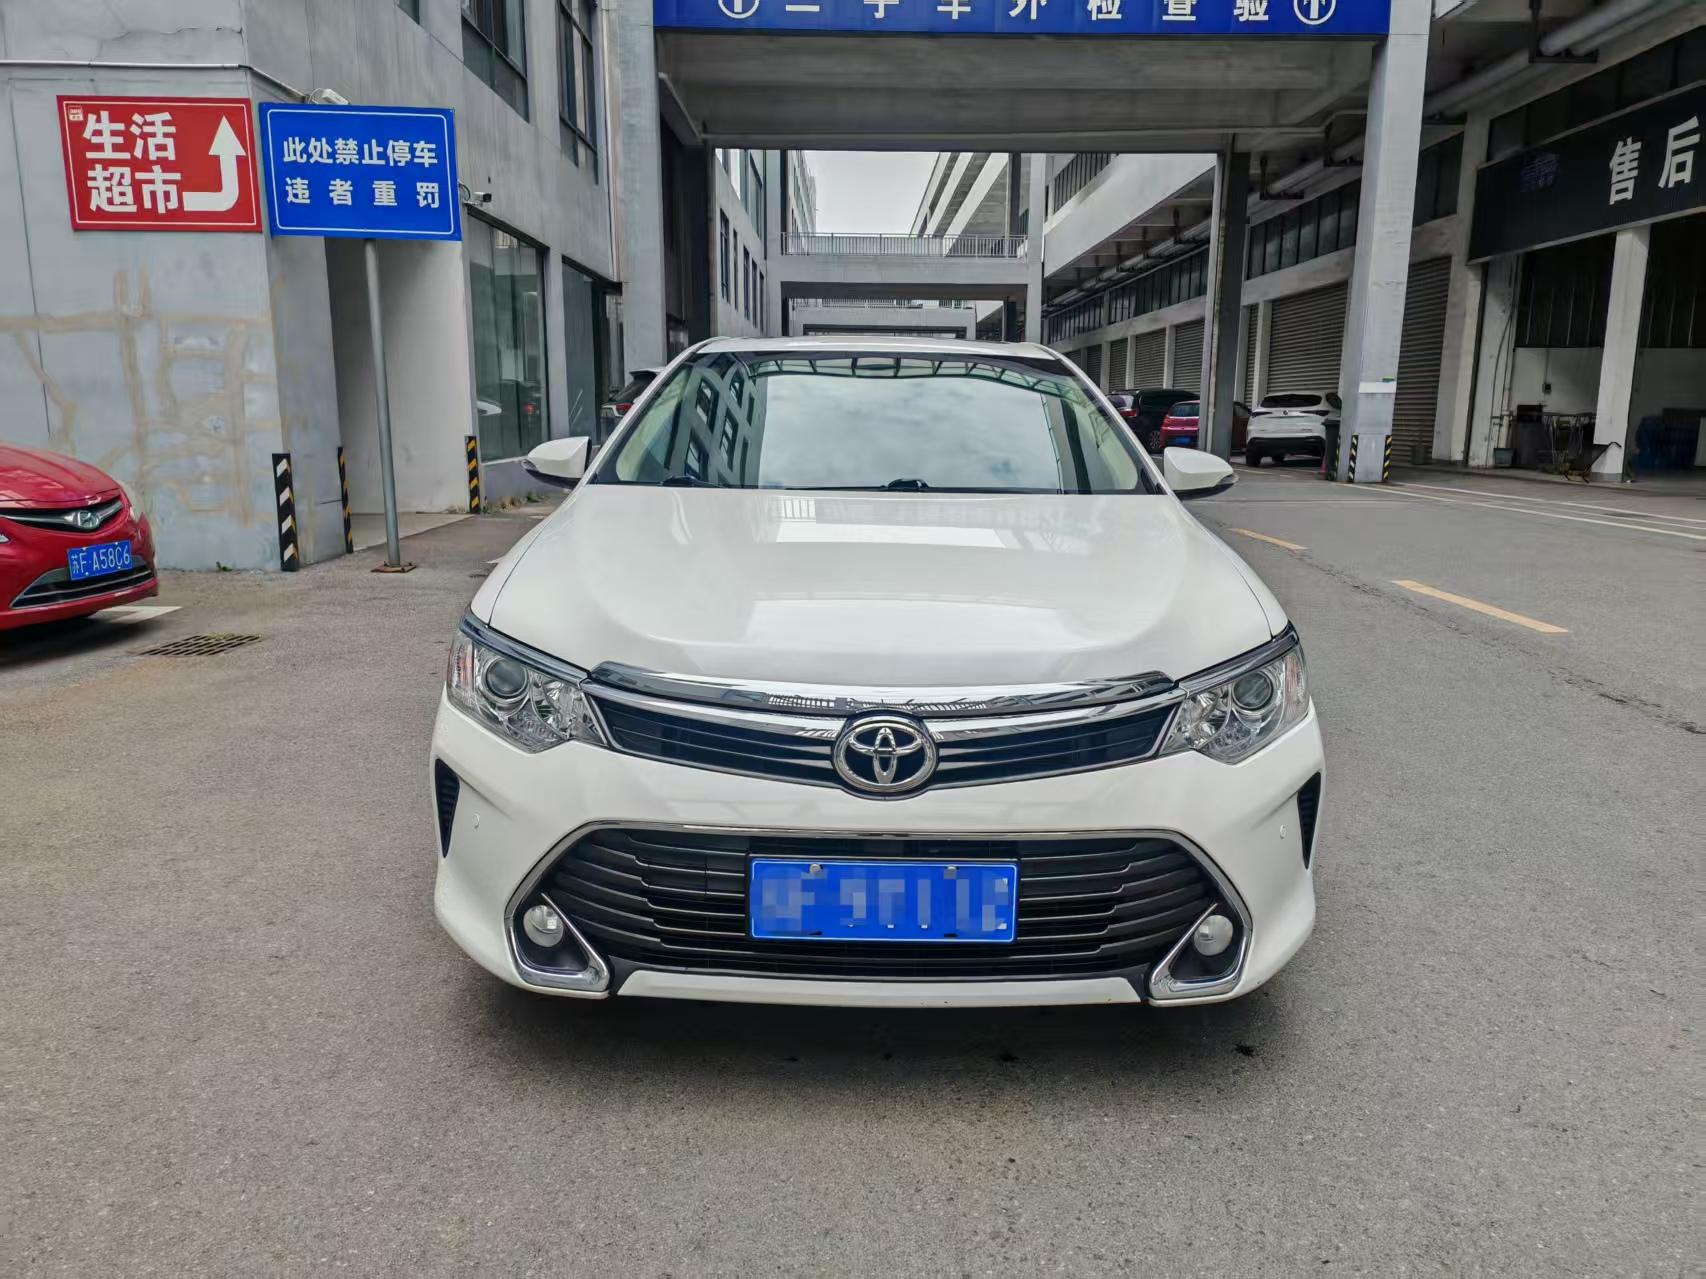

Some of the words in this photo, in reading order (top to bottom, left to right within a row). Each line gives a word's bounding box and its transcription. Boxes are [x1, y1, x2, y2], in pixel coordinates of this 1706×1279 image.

[83, 111, 176, 160] 生活
[283, 137, 438, 167] 此处禁止停车
[1608, 116, 1700, 205] 售后
[87, 164, 181, 213] 超市
[285, 177, 440, 209] 违者重罚
